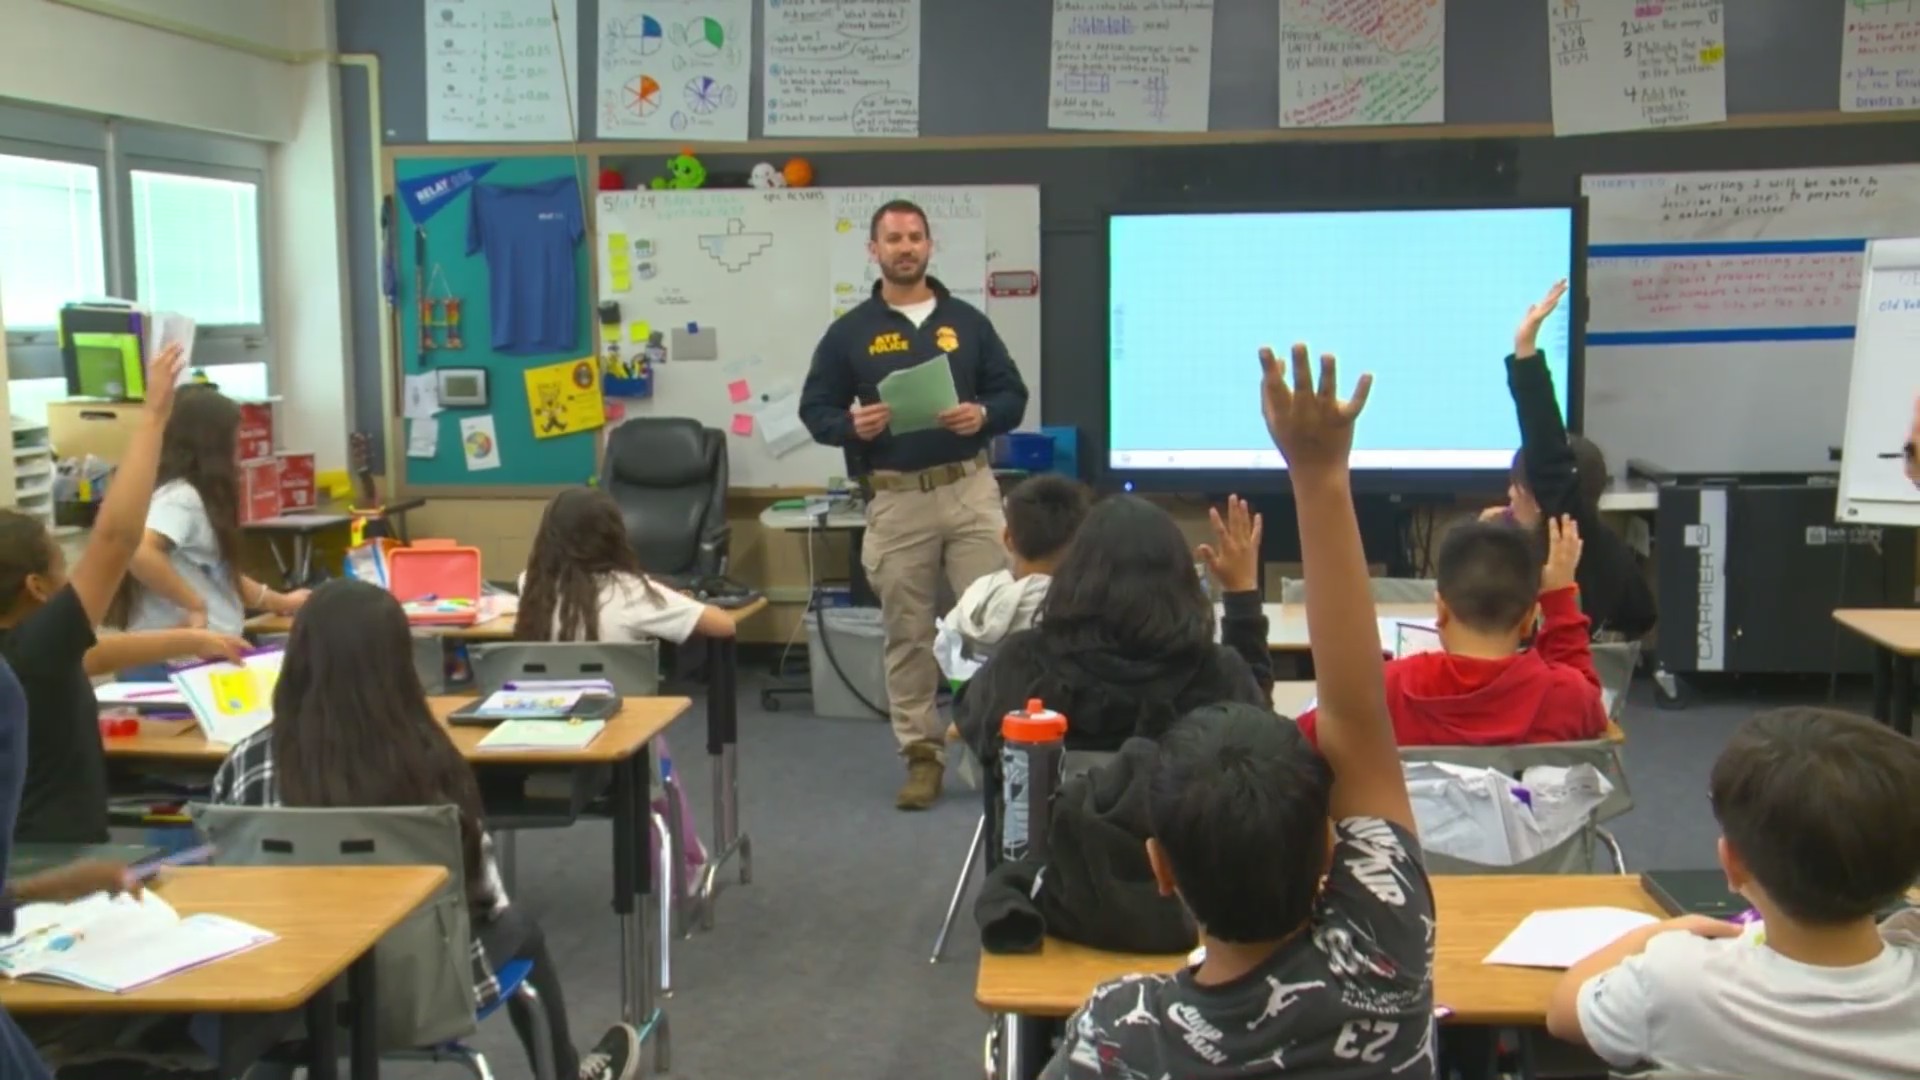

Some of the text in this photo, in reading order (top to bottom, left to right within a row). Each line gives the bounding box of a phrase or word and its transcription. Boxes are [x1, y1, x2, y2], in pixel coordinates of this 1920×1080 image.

[415, 177, 450, 205] RELAY
[1697, 179, 1744, 193] writing
[1768, 177, 1796, 189] will
[1805, 177, 1819, 189] be
[1829, 175, 1860, 187] able
[1868, 175, 1879, 186] to
[1660, 195, 1712, 210] describe
[1806, 190, 1851, 204] prepare
[1858, 186, 1878, 199] for
[1678, 207, 1723, 220] natural
[868, 338, 910, 357] POLICE
[1697, 552, 1715, 661] CARRIER
[1333, 1018, 1400, 1064] 23
